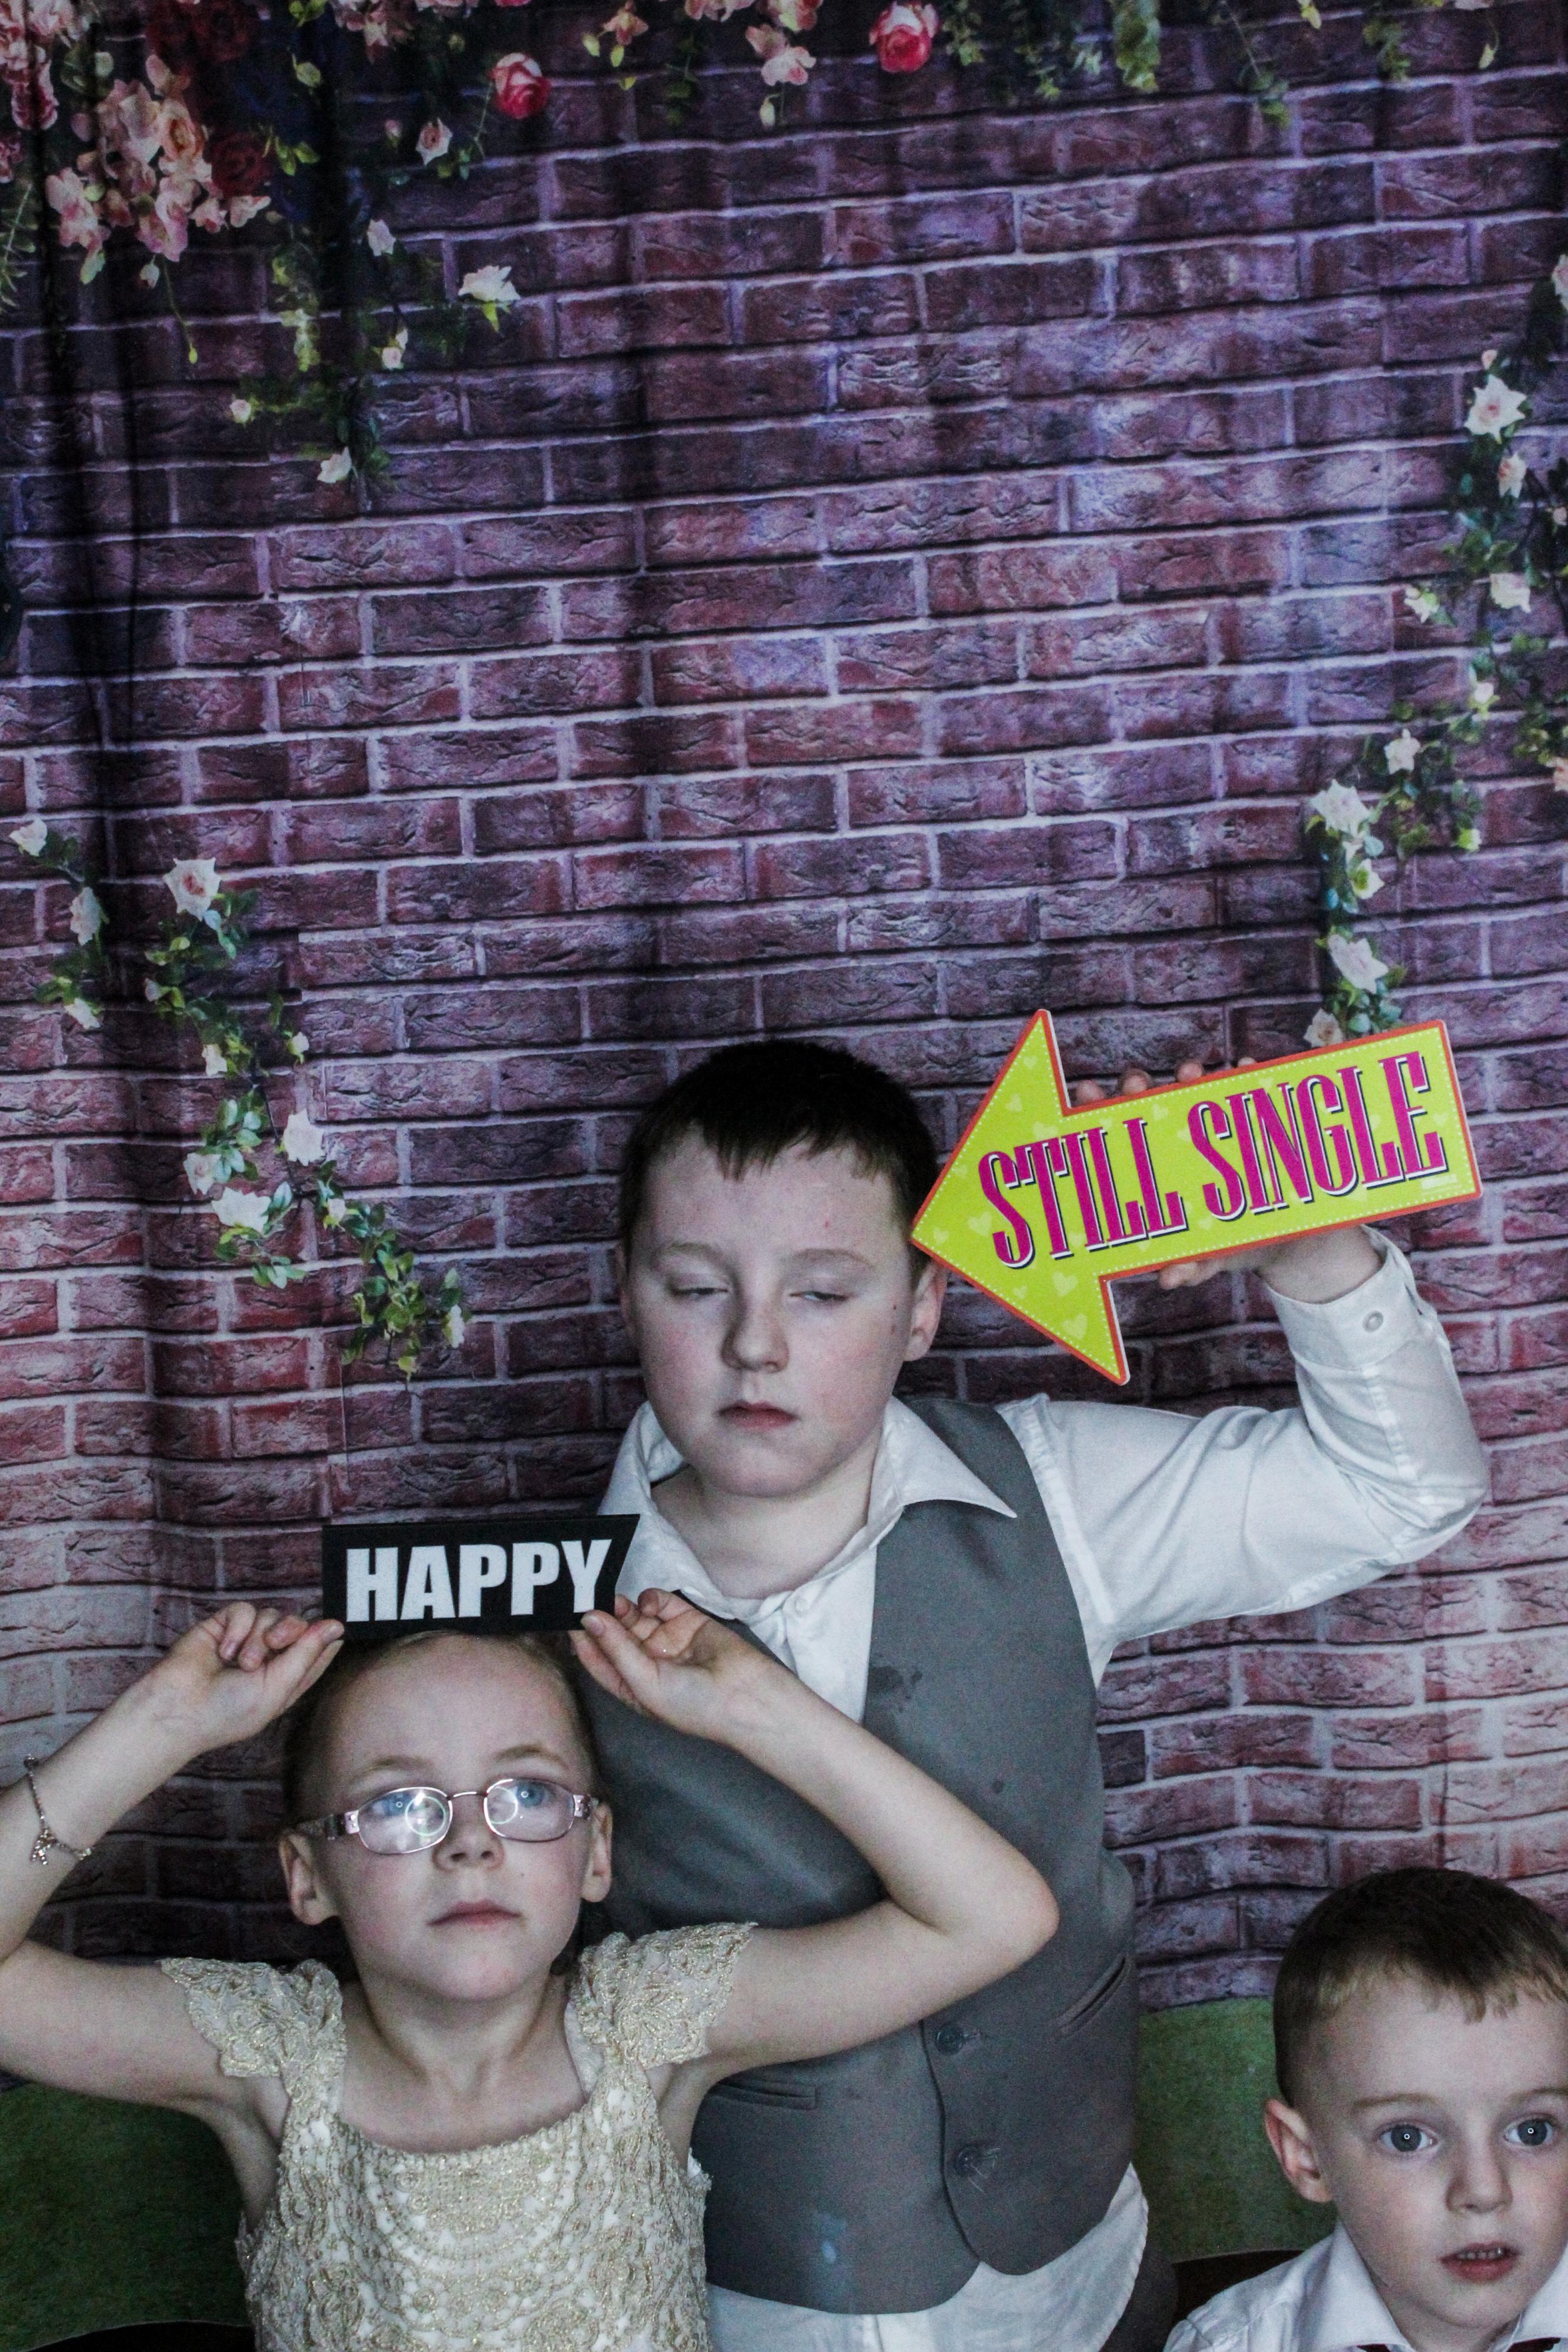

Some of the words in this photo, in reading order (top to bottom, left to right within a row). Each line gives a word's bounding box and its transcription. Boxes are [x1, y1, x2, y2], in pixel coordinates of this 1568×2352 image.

[978, 1118, 1187, 1268] STILL
[1188, 1051, 1447, 1221] SINGLE
[346, 1539, 612, 1622] HAPPY
